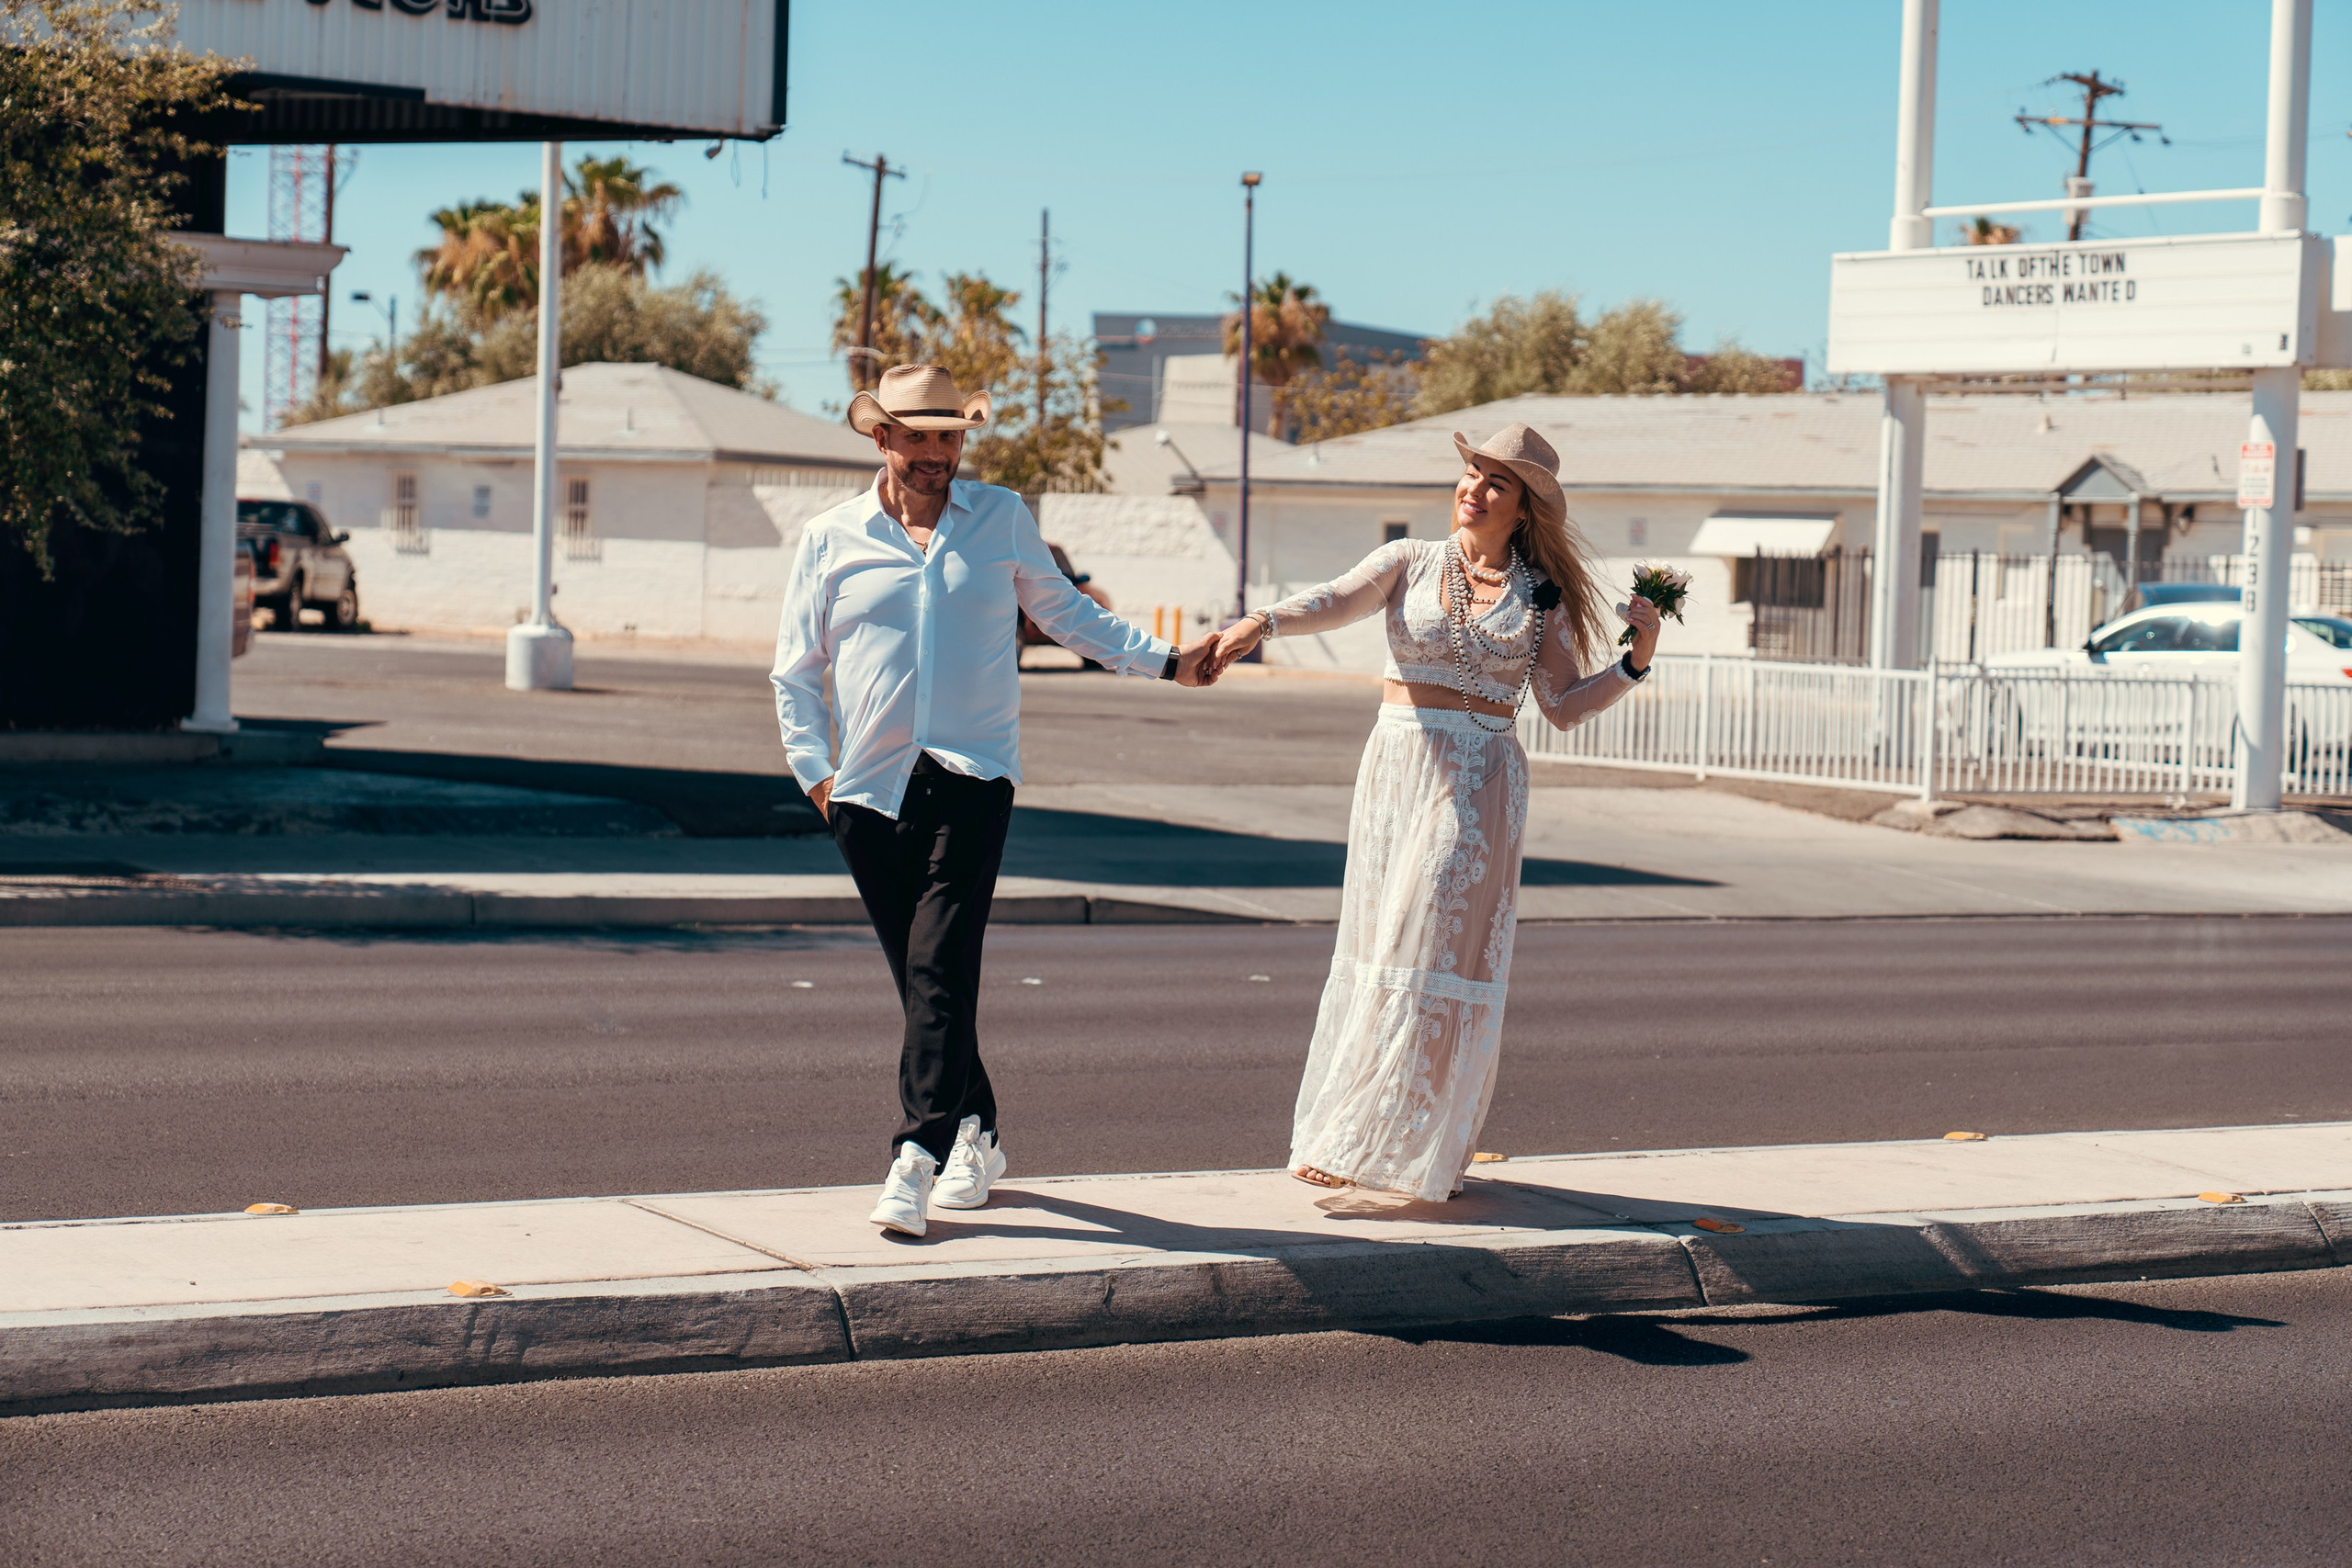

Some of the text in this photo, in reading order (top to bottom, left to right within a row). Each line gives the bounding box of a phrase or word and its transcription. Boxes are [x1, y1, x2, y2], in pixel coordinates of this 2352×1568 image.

[1966, 259, 2007, 278] TALK
[2078, 253, 2126, 274] TOWN
[1983, 279, 2136, 306] DANCERS WANTED
